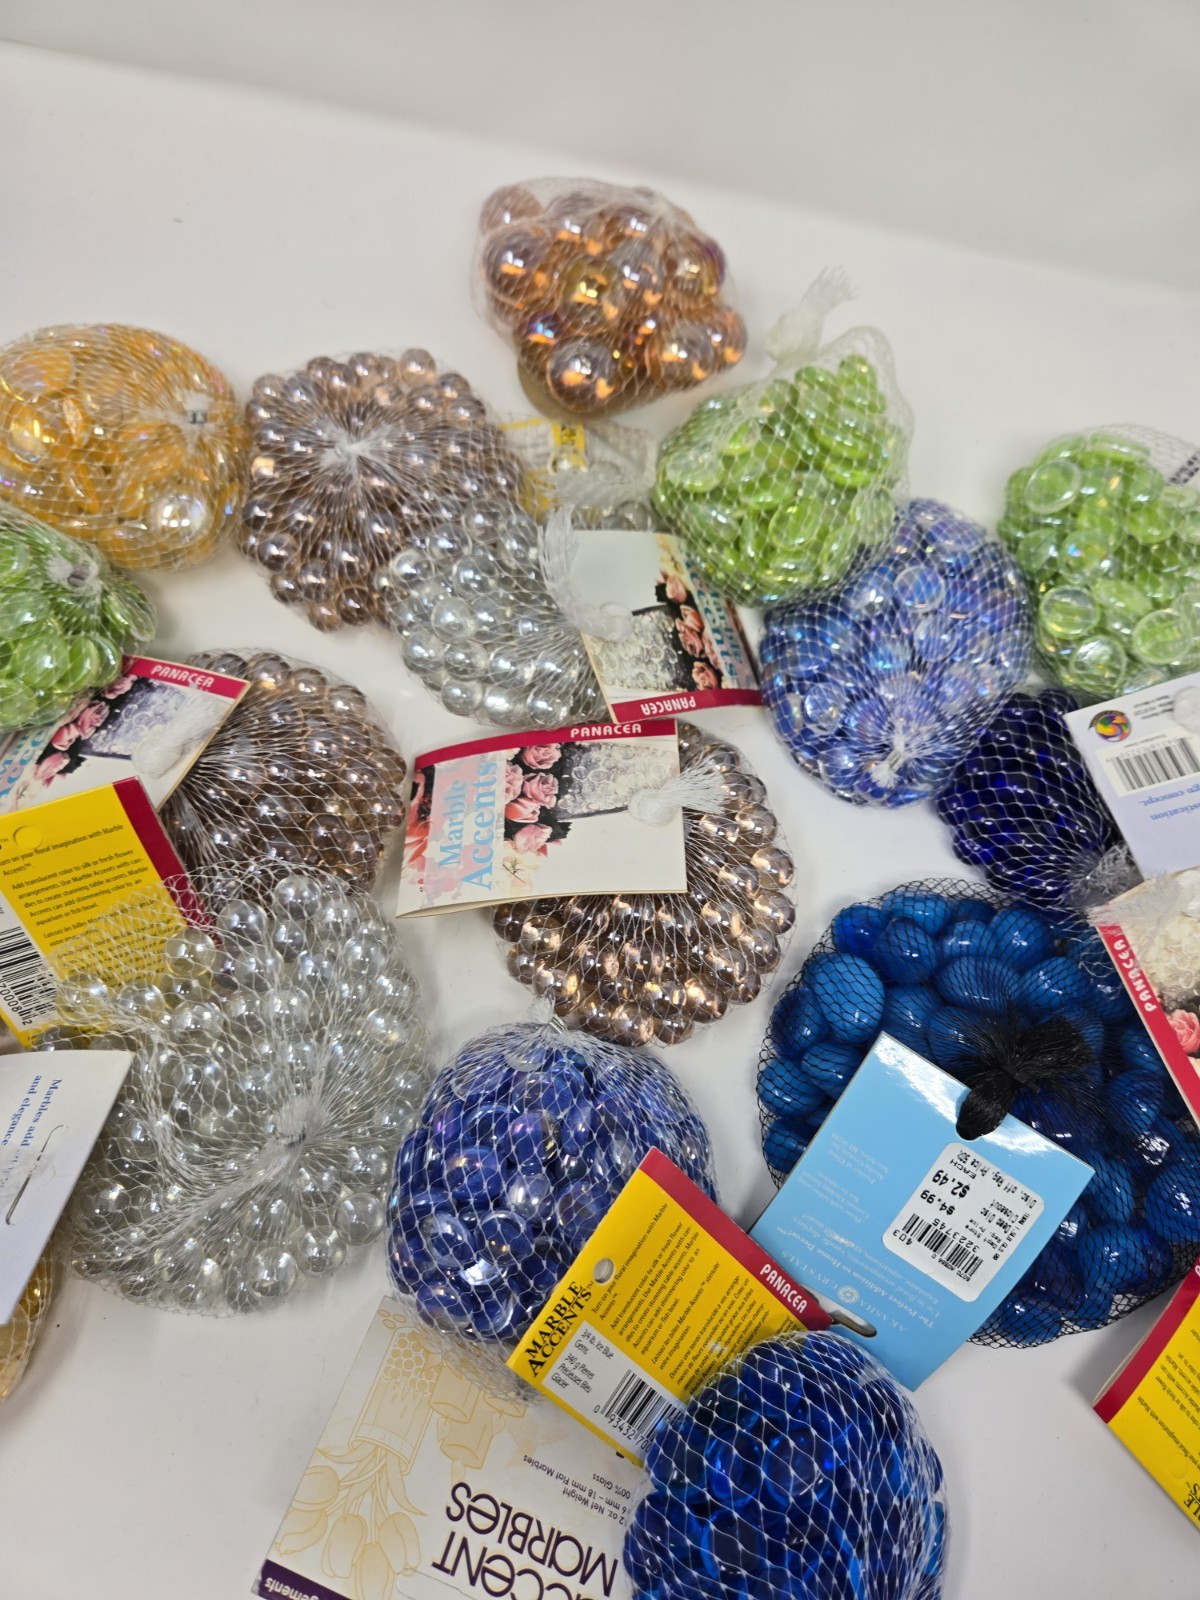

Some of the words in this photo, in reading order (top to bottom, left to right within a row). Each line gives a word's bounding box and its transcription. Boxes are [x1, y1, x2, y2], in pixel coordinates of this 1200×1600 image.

[151, 664, 215, 689] PANACEA
[640, 696, 697, 715] PANACEA
[570, 723, 642, 739] PANACEA
[437, 778, 468, 868] Marble
[461, 761, 499, 892] Accents
[1113, 938, 1158, 1013] PANACEA
[27, 1075, 43, 1095] and
[34, 1078, 63, 1124] Marbles
[0, 1096, 32, 1146] elegance
[21, 1125, 37, 1147] add
[955, 1148, 970, 1163] 50%
[949, 1157, 976, 1180] EACH
[968, 1157, 989, 1176] Price
[932, 1168, 972, 1201] $2.49
[987, 1168, 1006, 1187] Reg.
[1002, 1180, 1018, 1196] off
[919, 1186, 956, 1218] $4.99
[1016, 1190, 1037, 1209] Disc.
[978, 1206, 996, 1223] Disc
[988, 1198, 1019, 1223] Closeout
[931, 1215, 980, 1254] 3223745
[964, 1223, 982, 1238] Store
[968, 1217, 986, 1232] Price
[994, 1217, 1012, 1233] Deep
[891, 1227, 913, 1246] 403
[982, 1236, 997, 1249] Dept
[987, 1230, 1002, 1243] Reg.
[591, 1299, 603, 1313] Turn
[600, 1292, 608, 1301] on
[606, 1280, 617, 1293] your
[613, 1264, 627, 1280] floral
[623, 1233, 649, 1267] imagination
[643, 1220, 655, 1234] with
[652, 1202, 668, 1221] Marble
[814, 1246, 842, 1269] Home
[610, 1316, 621, 1329] Add
[617, 1287, 640, 1318] translucent
[636, 1274, 648, 1288] color
[649, 1257, 659, 1268] silk
[657, 1251, 663, 1259] or
[660, 1238, 672, 1252] fresh
[668, 1221, 683, 1239] flower
[841, 1262, 852, 1274] to
[617, 1297, 646, 1337] arrangements.
[642, 1286, 652, 1298] Use
[648, 1267, 664, 1287] Marble
[660, 1247, 677, 1269] Accents
[673, 1236, 685, 1250] with
[681, 1224, 692, 1237] can-
[760, 1263, 808, 1314] PANACEA
[850, 1269, 888, 1298] Addition
[632, 1326, 648, 1348] Accents
[646, 1317, 655, 1328] can
[652, 1305, 662, 1318] add
[658, 1275, 683, 1308] shimmering
[679, 1261, 691, 1276] color
[693, 1247, 700, 1255] an
[884, 1292, 917, 1318] Perfect
[524, 1279, 582, 1359] MARBLE
[916, 1313, 935, 1329] The
[573, 1338, 591, 1354] Gems
[580, 1328, 592, 1340] 3/4
[588, 1335, 598, 1345] lb.
[595, 1340, 605, 1351] Ice
[601, 1345, 615, 1359] Blue
[564, 1352, 577, 1365] 340
[572, 1361, 580, 1370] g
[577, 1362, 596, 1380] Pierres
[550, 1371, 570, 1389] Glacier
[592, 1403, 601, 1413] 0
[606, 1411, 637, 1441] 93432
[523, 1454, 554, 1476] Marbles
[554, 1471, 570, 1484] Flat
[569, 1479, 587, 1492] mm
[590, 1472, 614, 1490] Glass
[561, 1485, 591, 1505] Weight
[586, 1488, 597, 1499] 18
[603, 1497, 621, 1509] mm
[590, 1501, 605, 1512] Net
[605, 1509, 618, 1519] oz.
